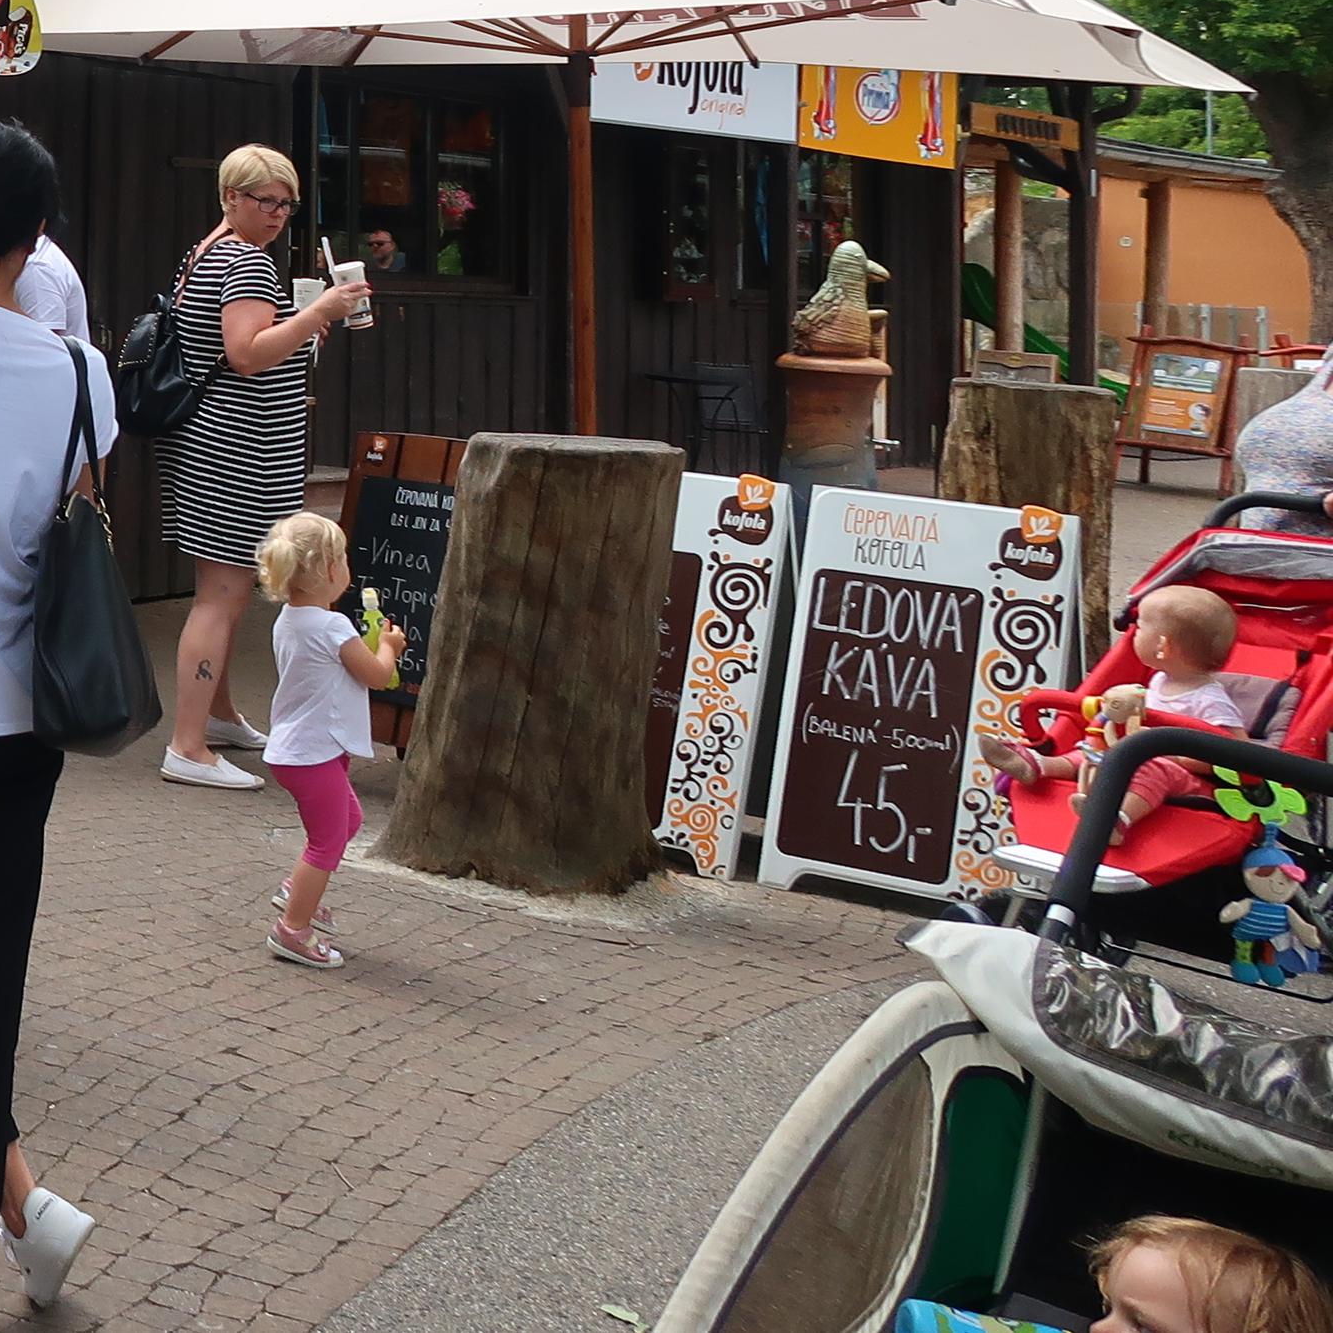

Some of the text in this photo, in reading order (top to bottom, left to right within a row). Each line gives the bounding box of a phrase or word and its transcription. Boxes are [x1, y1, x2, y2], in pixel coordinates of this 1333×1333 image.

[396, 487, 438, 509] ČEPOVANÁ
[722, 509, 766, 531] kofola
[843, 503, 940, 544] ČEPOVANÁ
[854, 538, 926, 571] KOFOLA
[1004, 542, 1055, 566] kofola
[813, 577, 976, 652] LEDOVÁ
[822, 641, 937, 718] KÁVA
